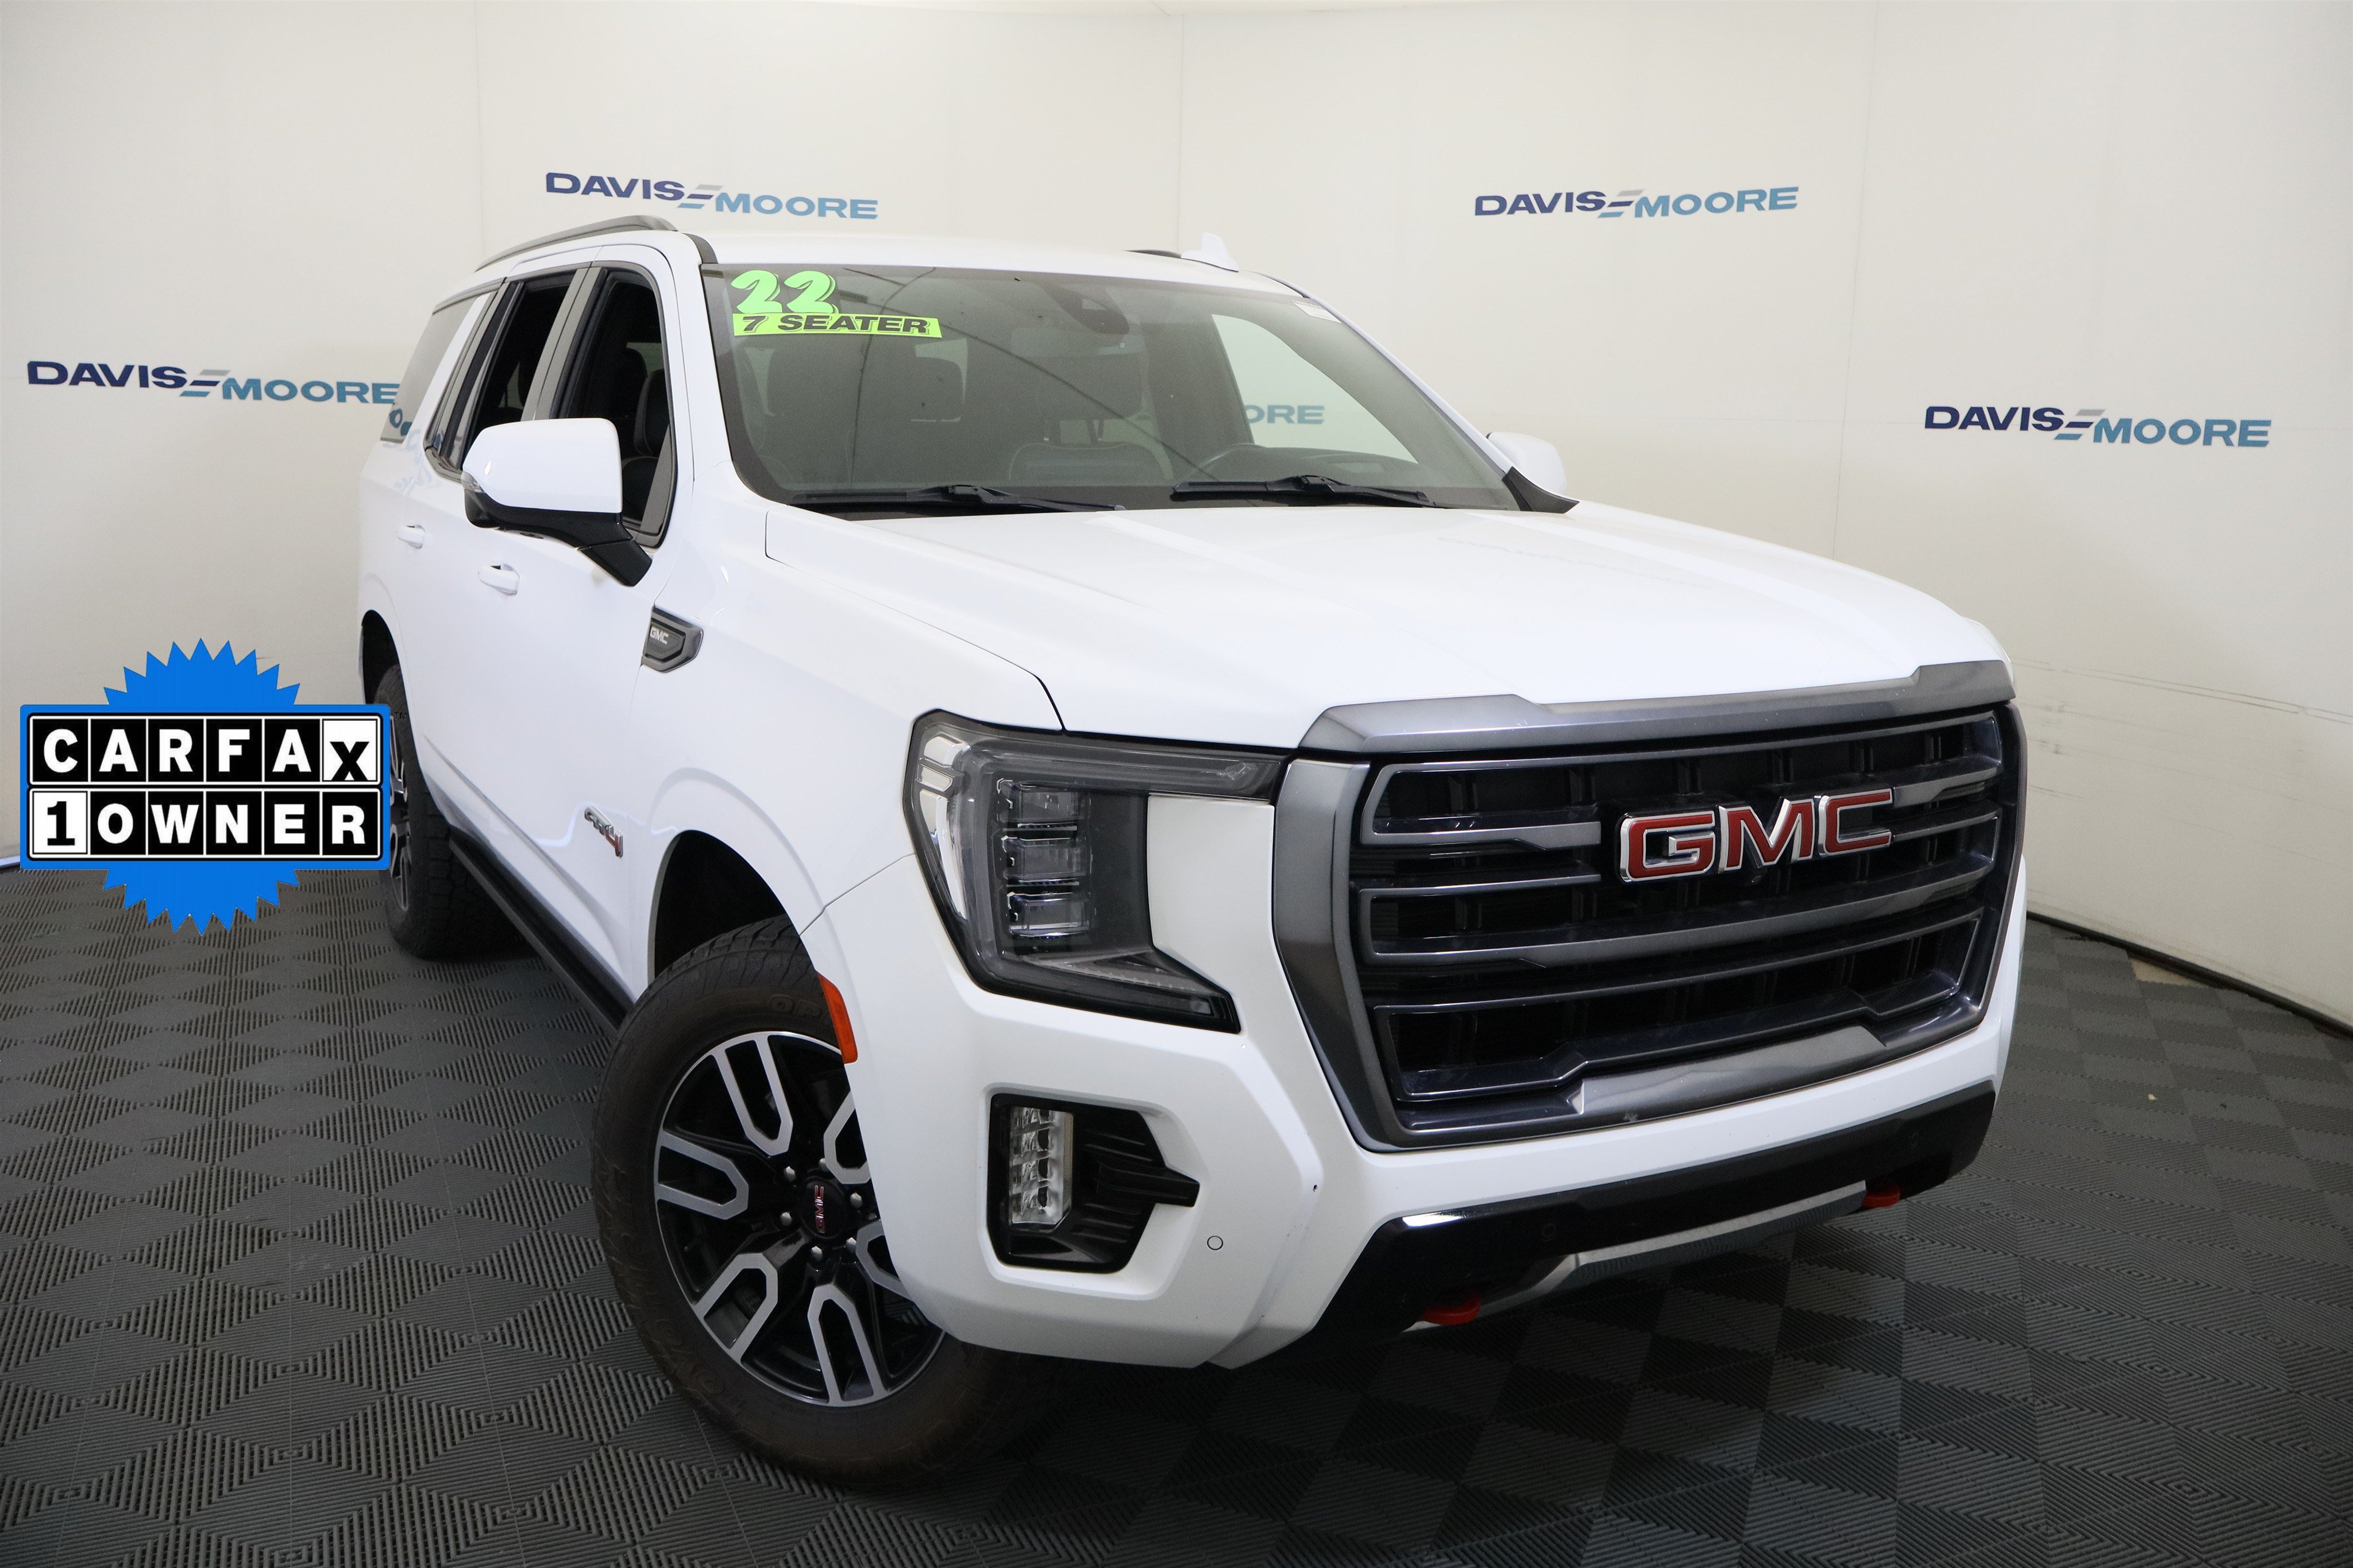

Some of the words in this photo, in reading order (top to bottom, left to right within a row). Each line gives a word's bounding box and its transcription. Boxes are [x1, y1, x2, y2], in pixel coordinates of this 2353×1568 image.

[546, 172, 685, 201] DAVIS
[716, 192, 878, 220] MOORE
[1475, 191, 1607, 216] DAVIS
[1634, 187, 1799, 218] MOORE
[731, 269, 839, 314] 22
[742, 315, 769, 333] 7
[777, 315, 932, 335] SEATER
[27, 361, 188, 389] DAVIS
[222, 379, 400, 404] MOORE
[1924, 405, 2065, 431] DAVIS
[2093, 418, 2273, 447] MOORE
[650, 626, 669, 645] GMC
[1619, 788, 1892, 883] GMC
[814, 1185, 826, 1234] GMC
